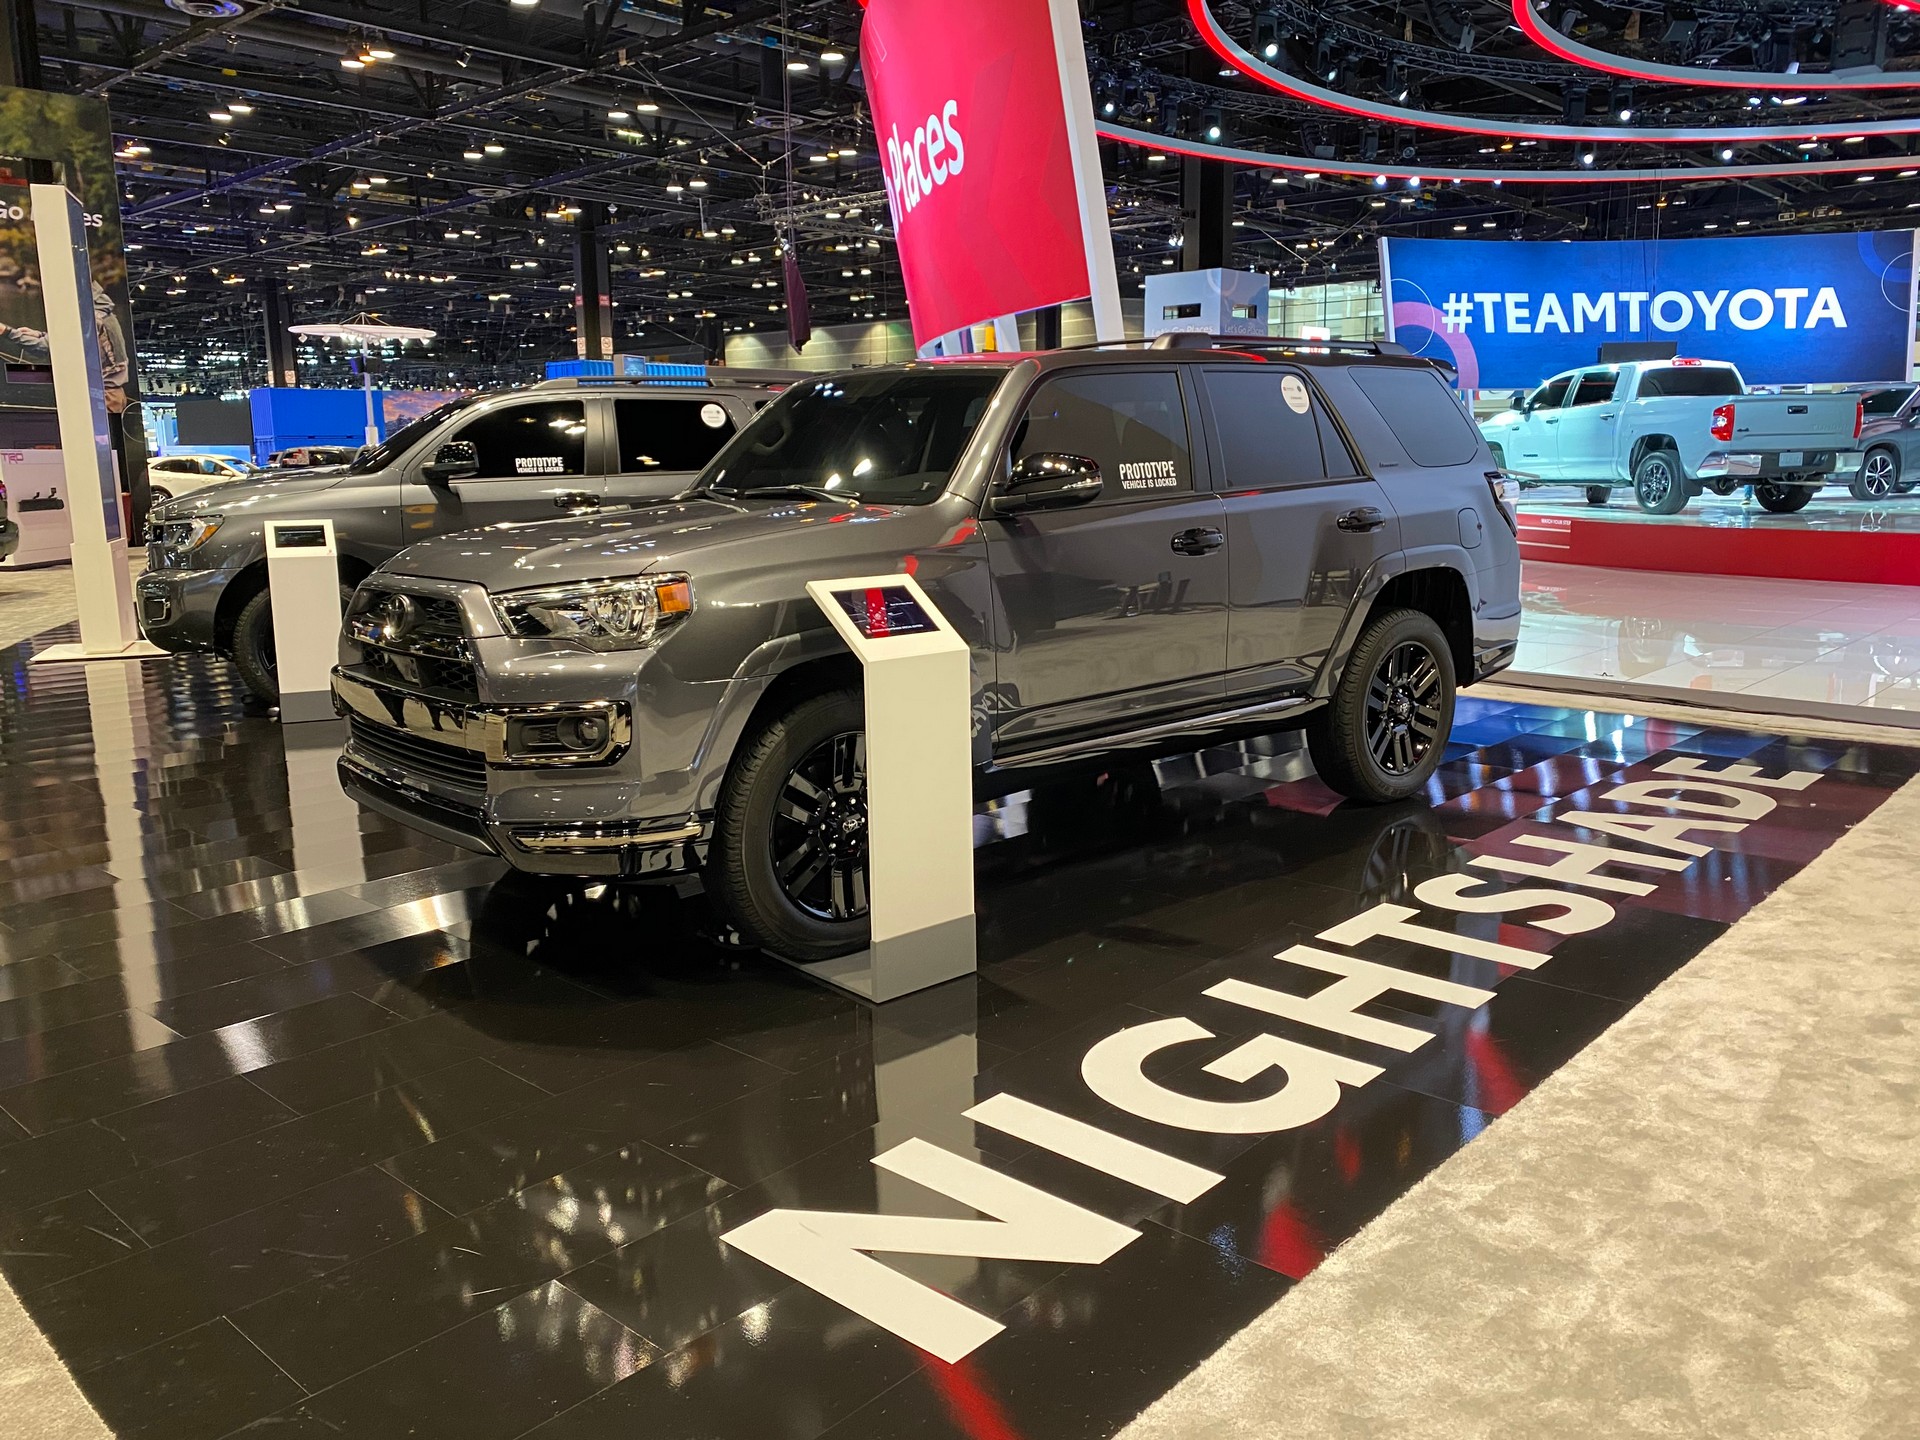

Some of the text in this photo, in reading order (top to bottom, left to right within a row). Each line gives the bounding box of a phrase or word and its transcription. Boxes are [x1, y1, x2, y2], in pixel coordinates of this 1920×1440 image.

[887, 99, 964, 223] Places
[1441, 286, 1848, 334] #TEAMTOYOTA
[515, 457, 564, 468] PROTOTYPE
[1119, 460, 1177, 480] PROTOTYPE
[1121, 477, 1177, 490] VEHICLE IS LOCKED
[719, 757, 1825, 1364] NIGHTSHADE
